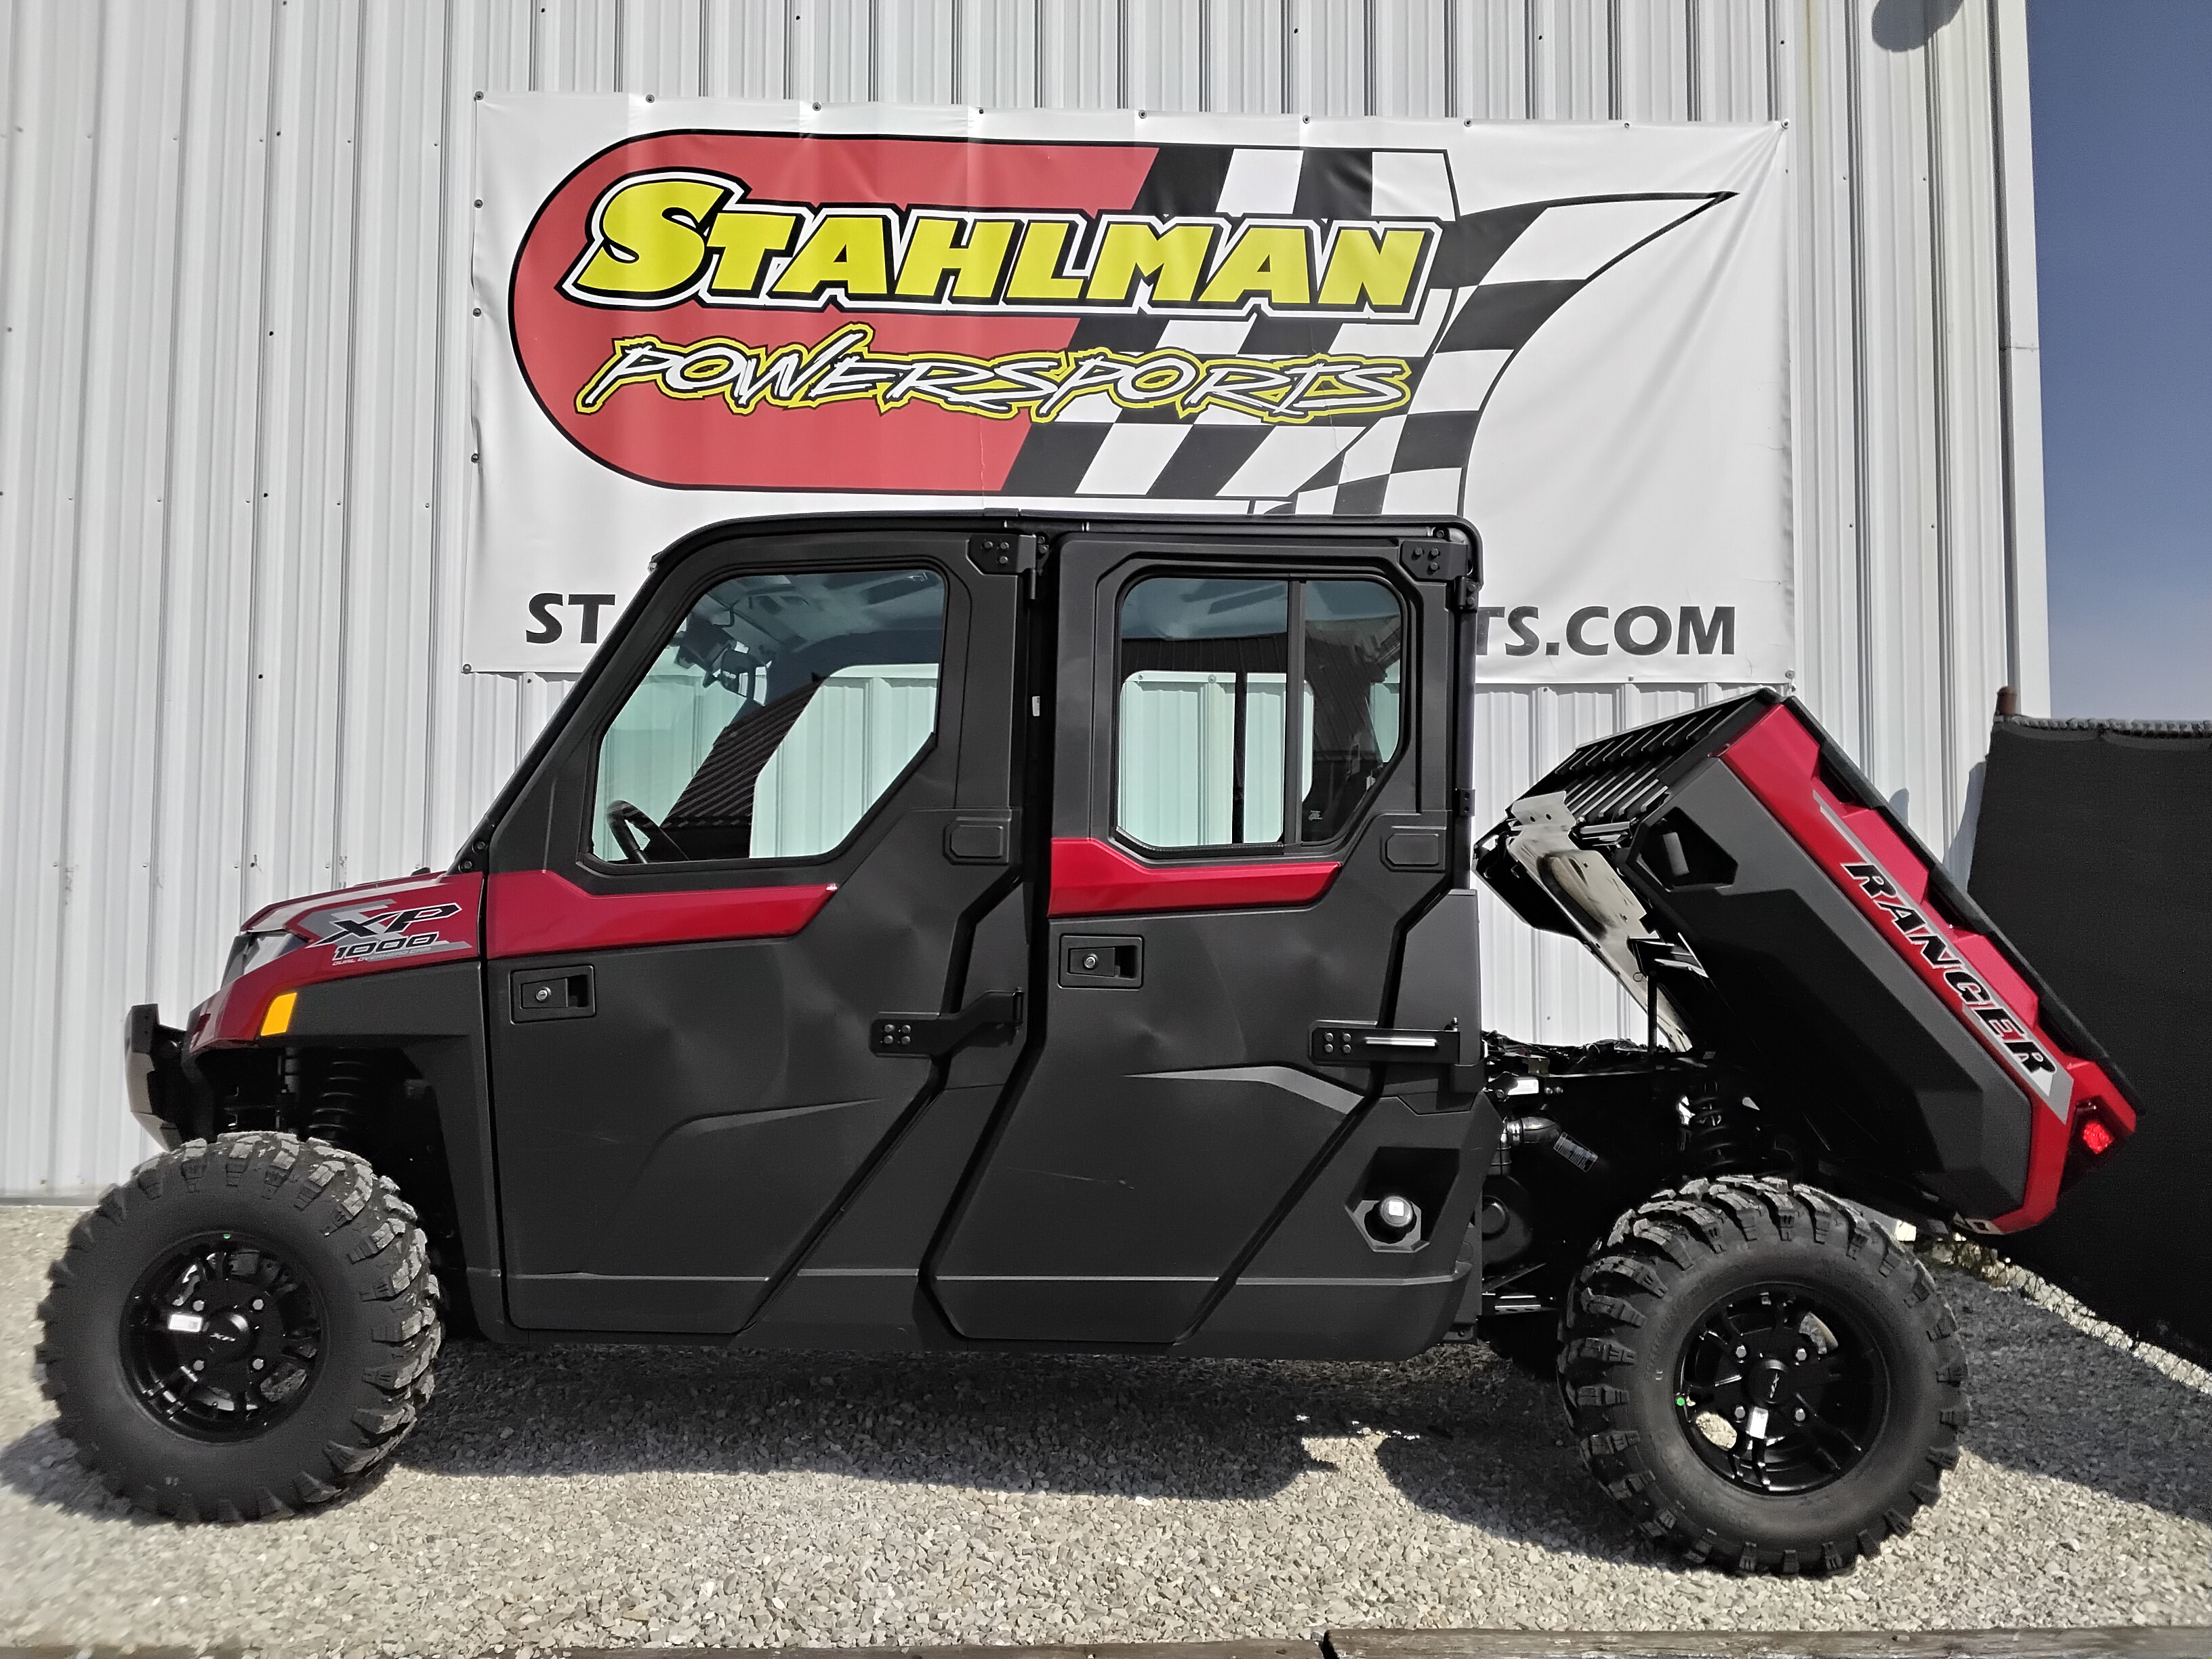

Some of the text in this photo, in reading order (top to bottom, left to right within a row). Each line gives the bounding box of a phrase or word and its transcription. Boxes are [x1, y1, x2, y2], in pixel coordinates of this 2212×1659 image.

[564, 173, 1439, 320] STAHLMAN
[579, 327, 1408, 423] POWERSPORTS
[305, 902, 463, 949] XP
[332, 931, 439, 961] 1000
[1841, 857, 2057, 1073] RANGER
